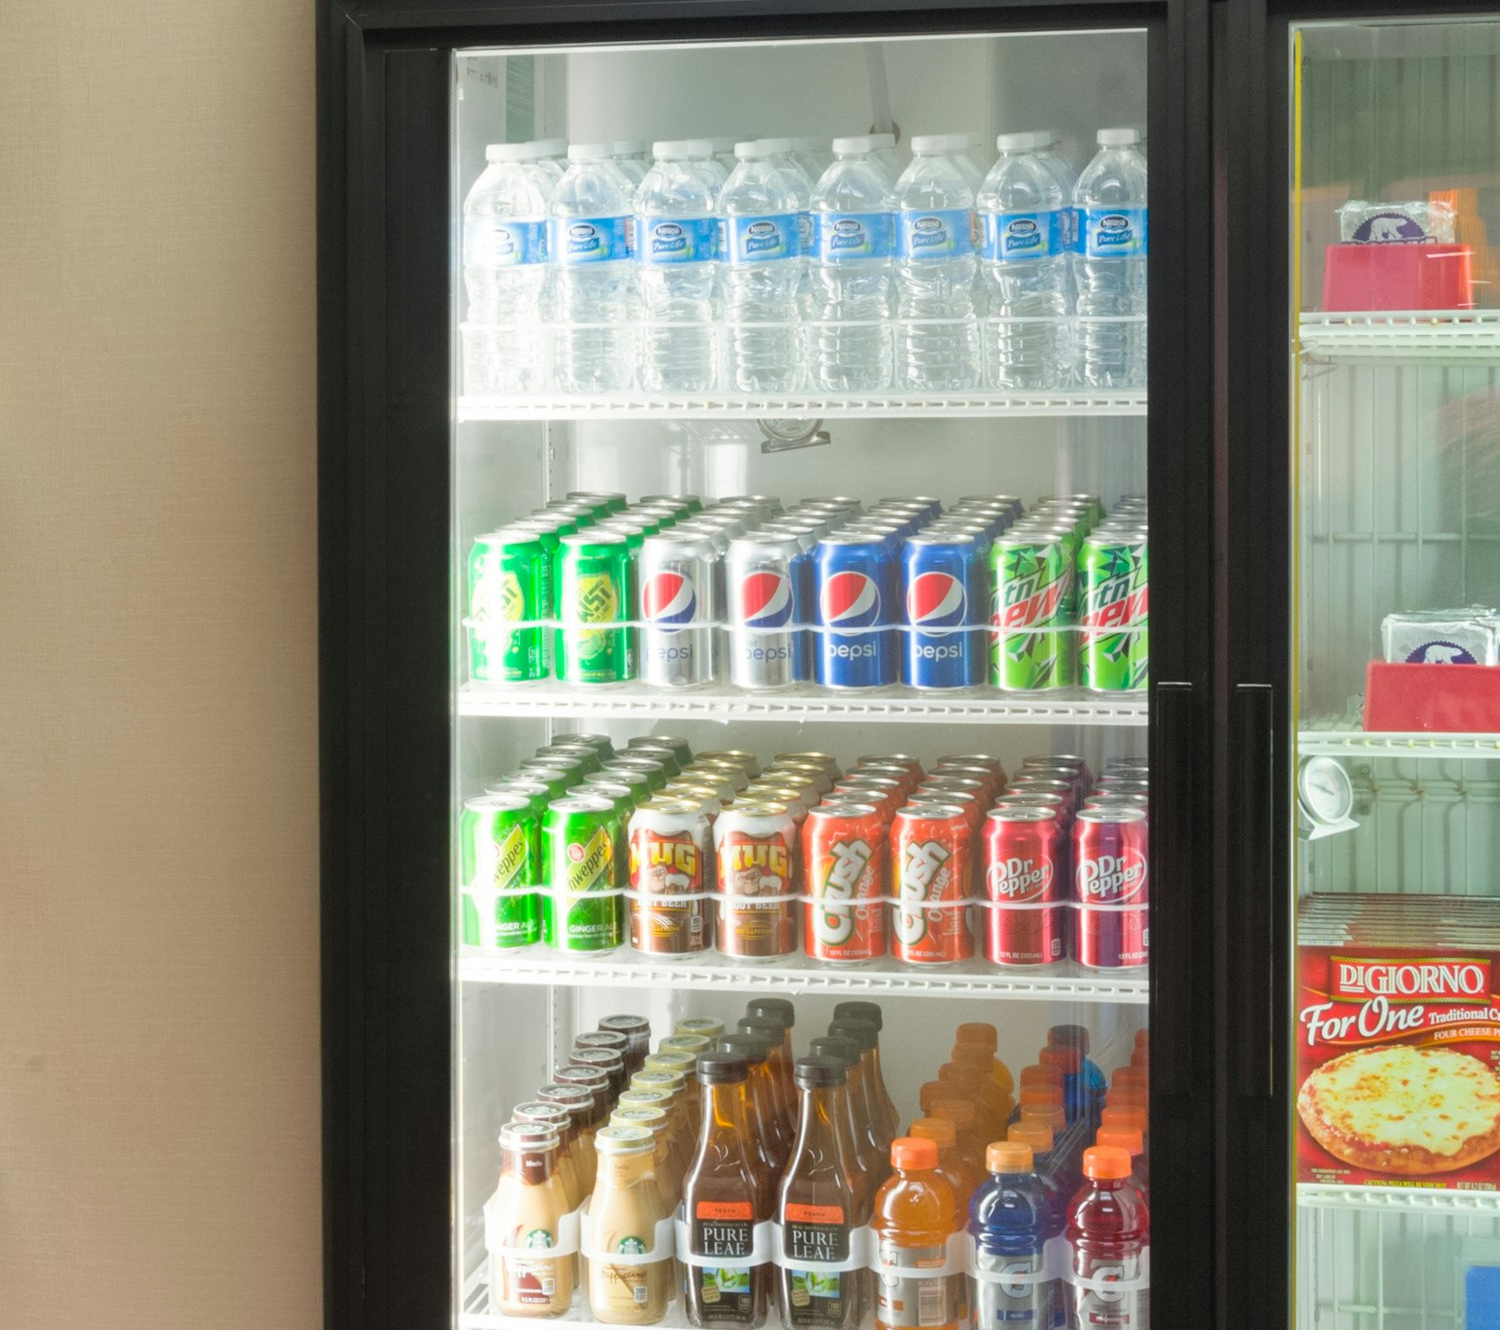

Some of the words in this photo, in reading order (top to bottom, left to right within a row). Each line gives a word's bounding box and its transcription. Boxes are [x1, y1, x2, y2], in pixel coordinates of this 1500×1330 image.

[1300, 1003, 1356, 1046] For
[1358, 995, 1424, 1037] One
[1429, 1009, 1488, 1025] Traditional
[1434, 1030, 1456, 1040] FOUR
[1459, 1027, 1491, 1037] CHEESE
[703, 1227, 749, 1242] PURE
[792, 1229, 839, 1246] PURE
